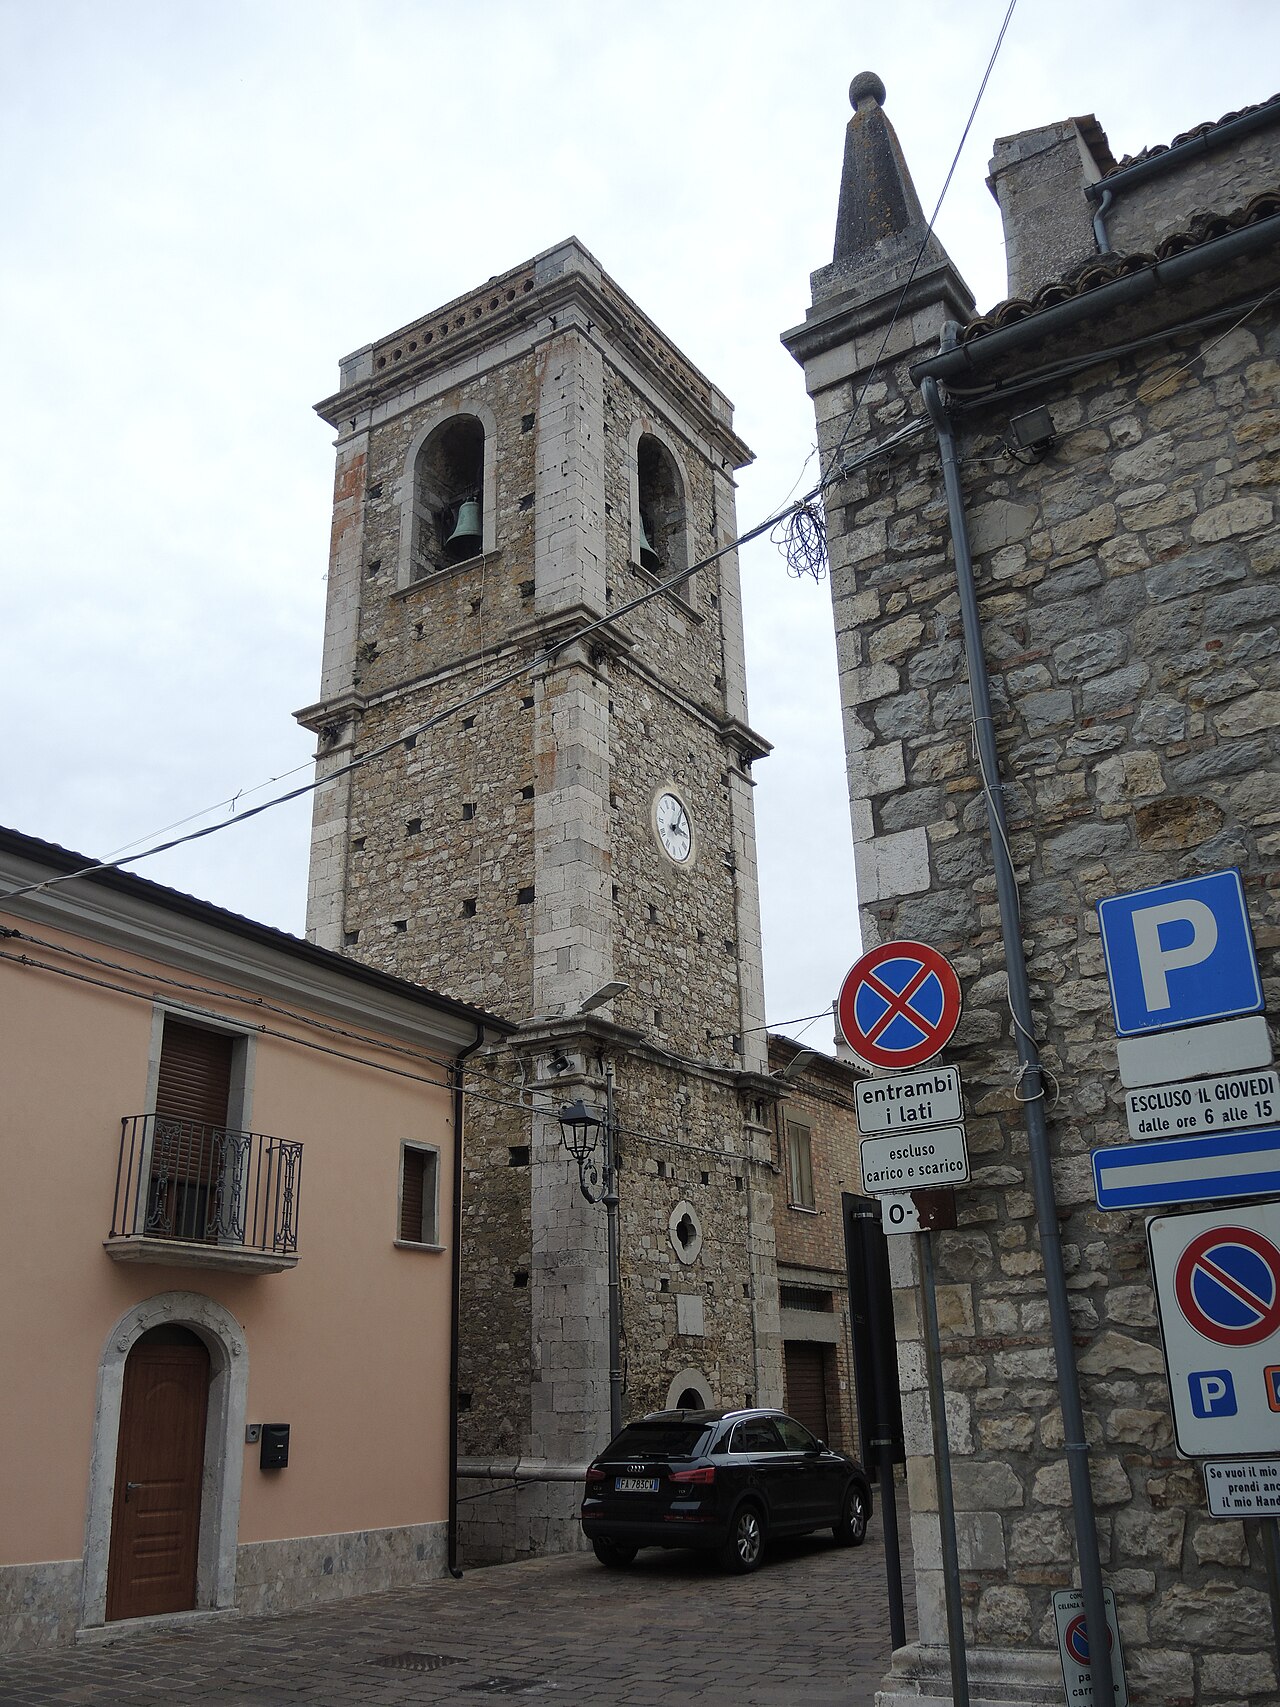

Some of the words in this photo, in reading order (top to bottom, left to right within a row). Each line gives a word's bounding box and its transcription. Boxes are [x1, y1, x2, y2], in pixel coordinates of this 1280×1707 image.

[1131, 899, 1218, 1012] P
[862, 1074, 953, 1104] entrambi
[1131, 1089, 1192, 1113] ESCLUSO
[1198, 1088, 1212, 1104] IL
[1214, 1076, 1274, 1101] GIOVEDI
[886, 1108, 891, 1124] i
[899, 1102, 933, 1123] lati
[1138, 1117, 1170, 1133] dalle
[1176, 1116, 1197, 1128] ore
[1204, 1108, 1214, 1124] 6
[1222, 1107, 1249, 1123] alle
[1254, 1099, 1273, 1118] 15
[889, 1143, 935, 1160] escluso
[866, 1166, 903, 1183] carico
[907, 1167, 914, 1177] e
[918, 1159, 963, 1176] scarico
[1199, 1376, 1227, 1413] P
[1210, 1468, 1222, 1479] Se
[1224, 1467, 1246, 1478] vuoi
[1248, 1466, 1257, 1477] il
[1259, 1466, 1278, 1477] mio
[1228, 1481, 1260, 1495] prendi
[1222, 1497, 1231, 1508] il
[1234, 1496, 1252, 1507] mio
